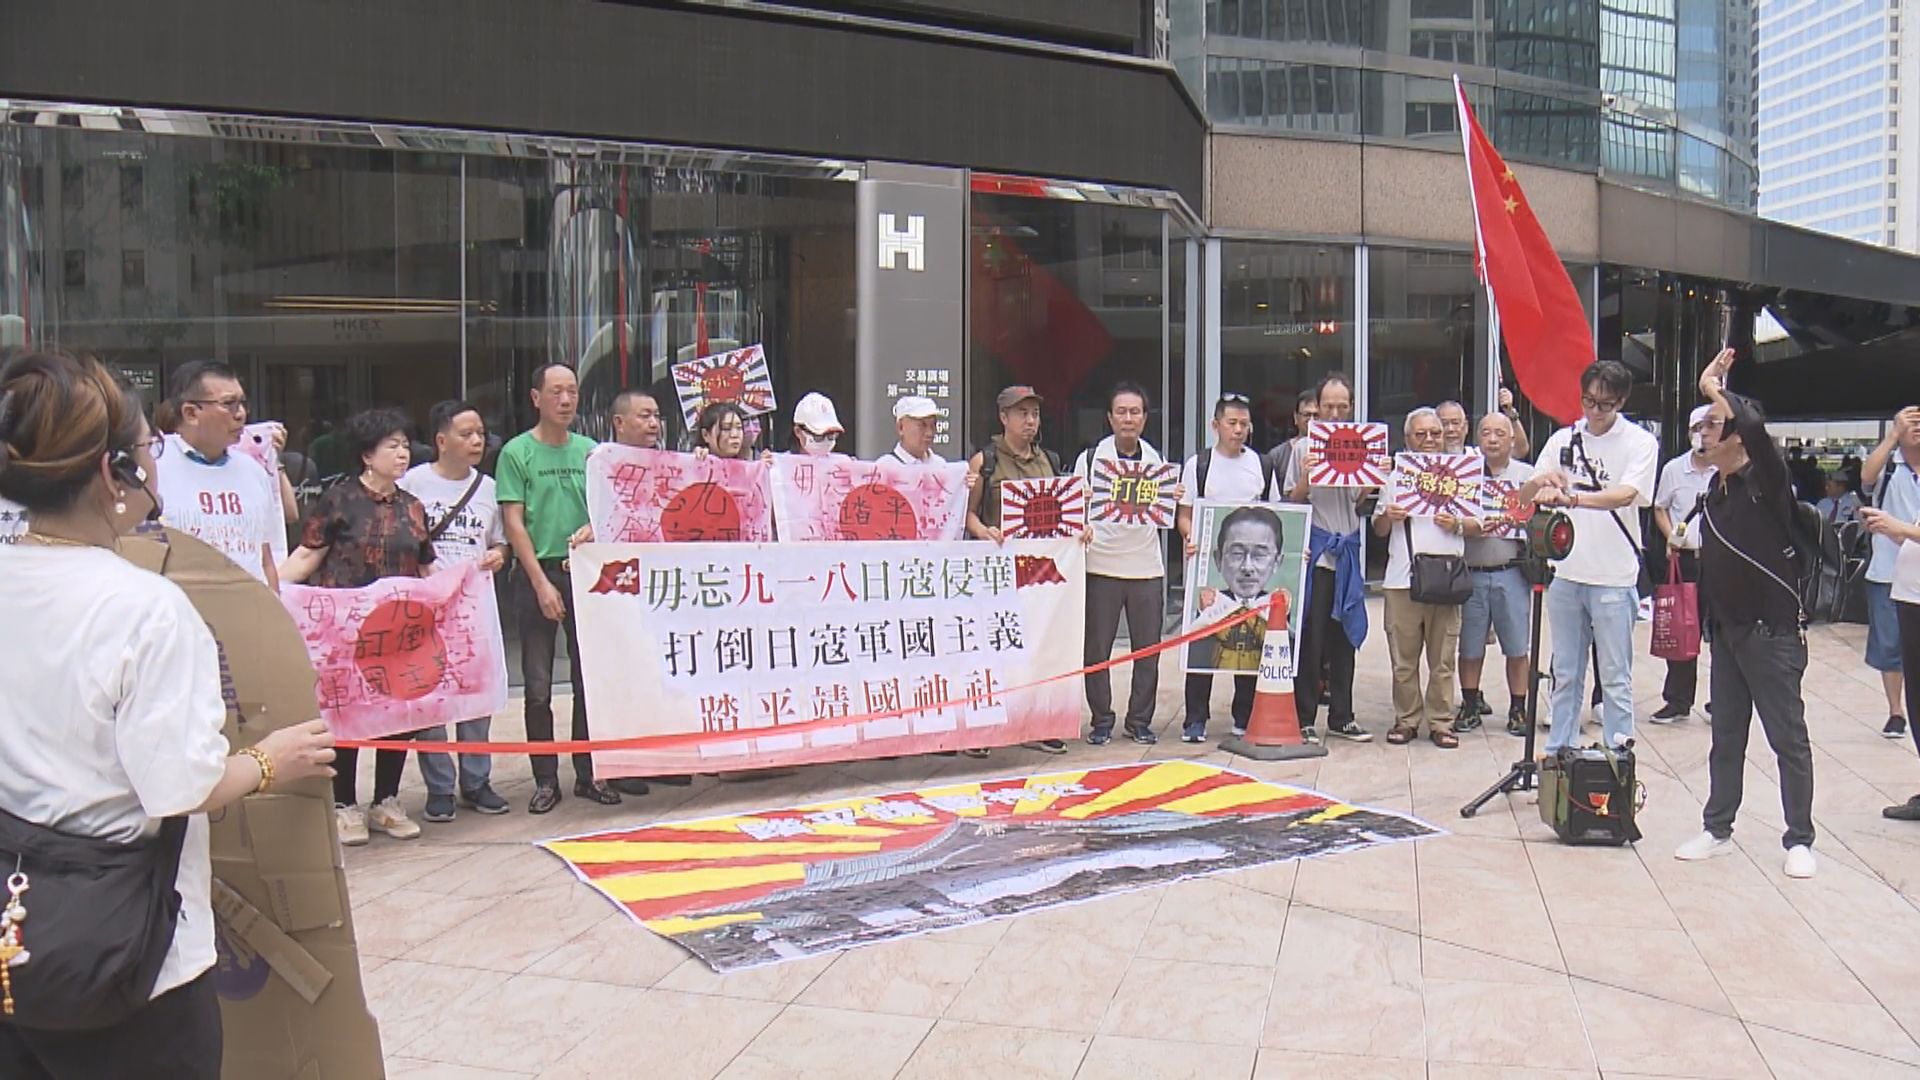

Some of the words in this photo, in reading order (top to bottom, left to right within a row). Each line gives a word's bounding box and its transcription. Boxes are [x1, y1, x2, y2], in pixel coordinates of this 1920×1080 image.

[199, 491, 242, 515] 9.18
[1110, 477, 1160, 505] 打倒
[643, 554, 1014, 612] 毋忘九一八日寇侵華
[663, 610, 1025, 678] 打倒日寇軍國主義
[1263, 643, 1290, 658] 警察
[699, 667, 1002, 734] 踏平靖國神社
